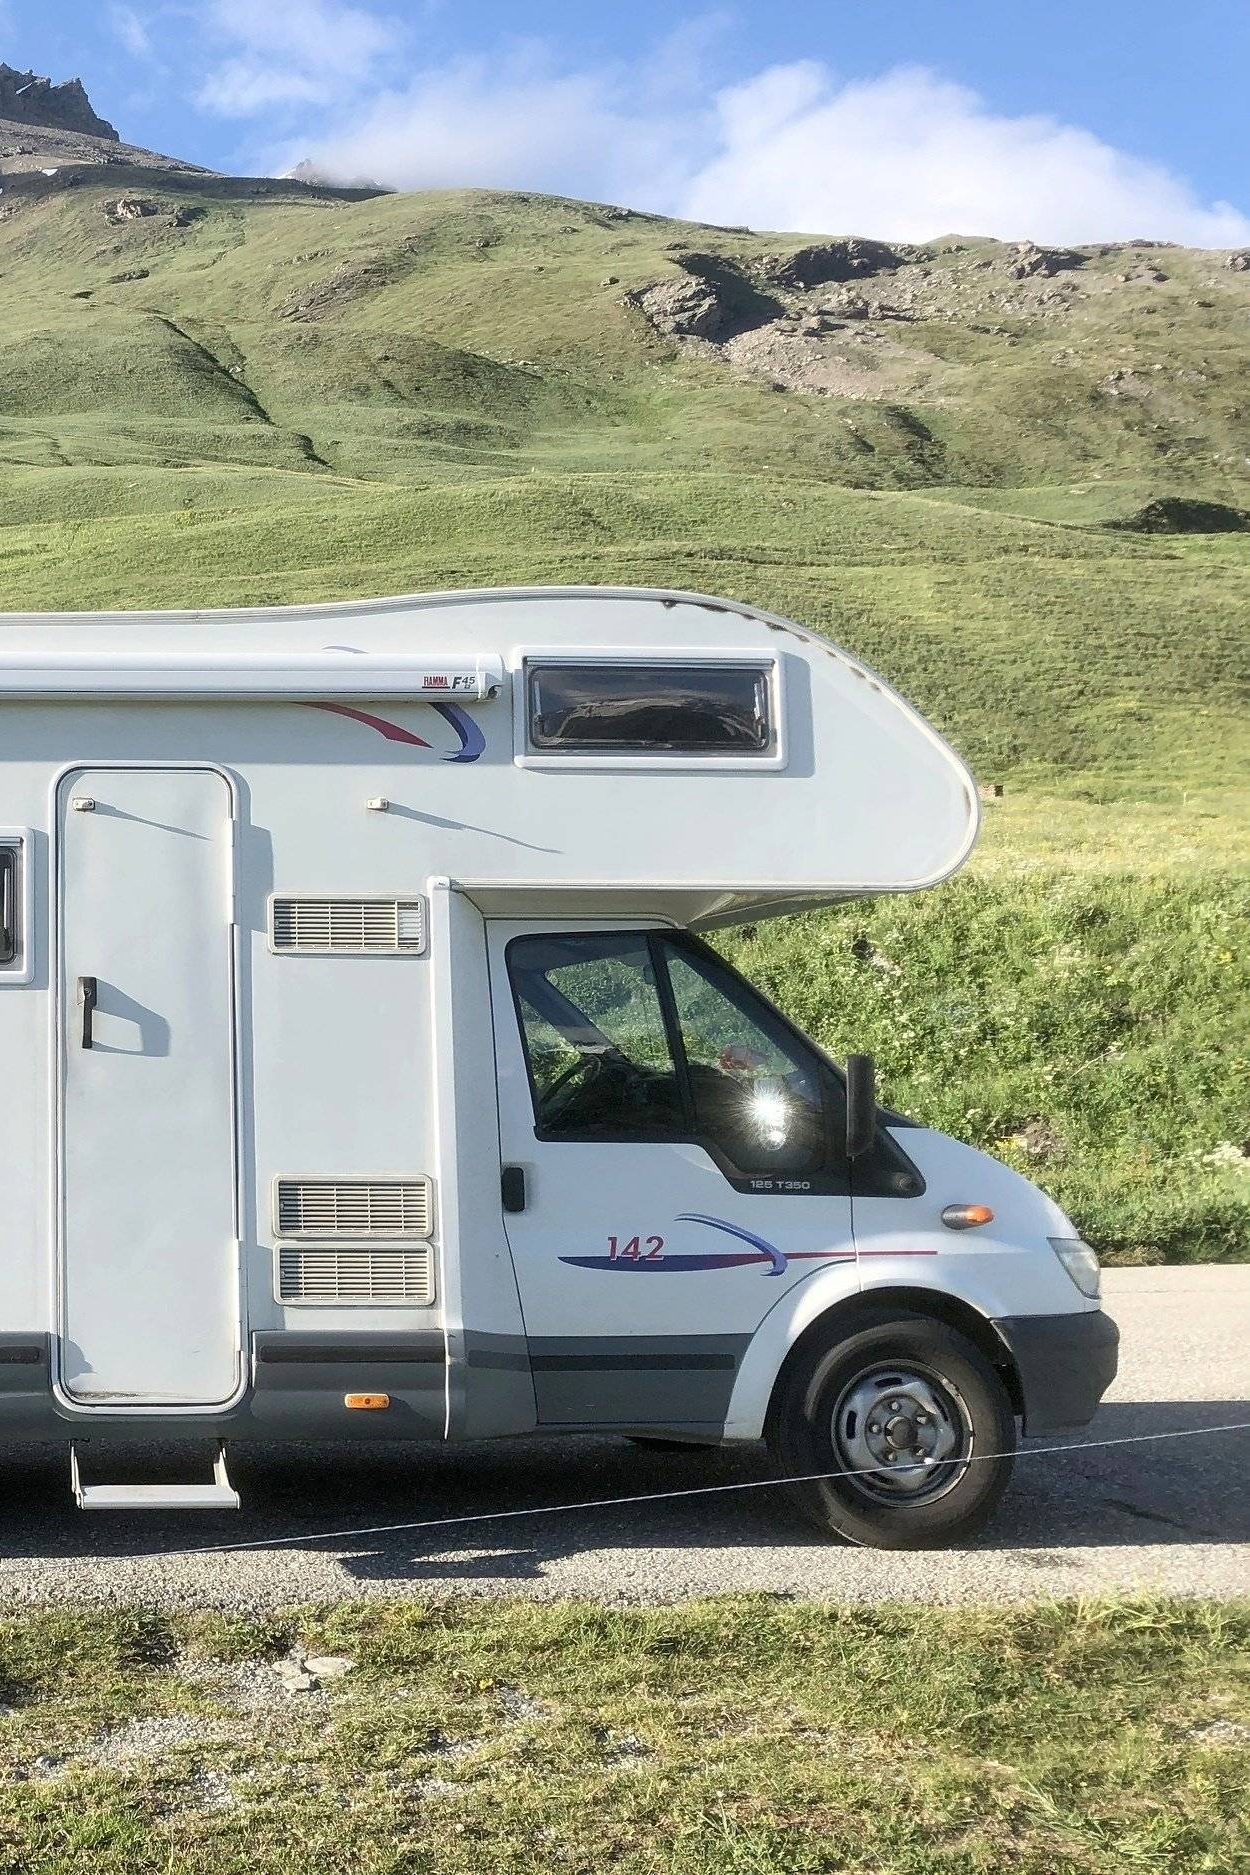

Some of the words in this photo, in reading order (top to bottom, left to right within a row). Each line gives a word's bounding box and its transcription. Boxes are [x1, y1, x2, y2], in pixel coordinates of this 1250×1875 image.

[750, 1180, 773, 1189] 125
[776, 1181, 811, 1190] T350
[607, 1235, 665, 1261] 142
